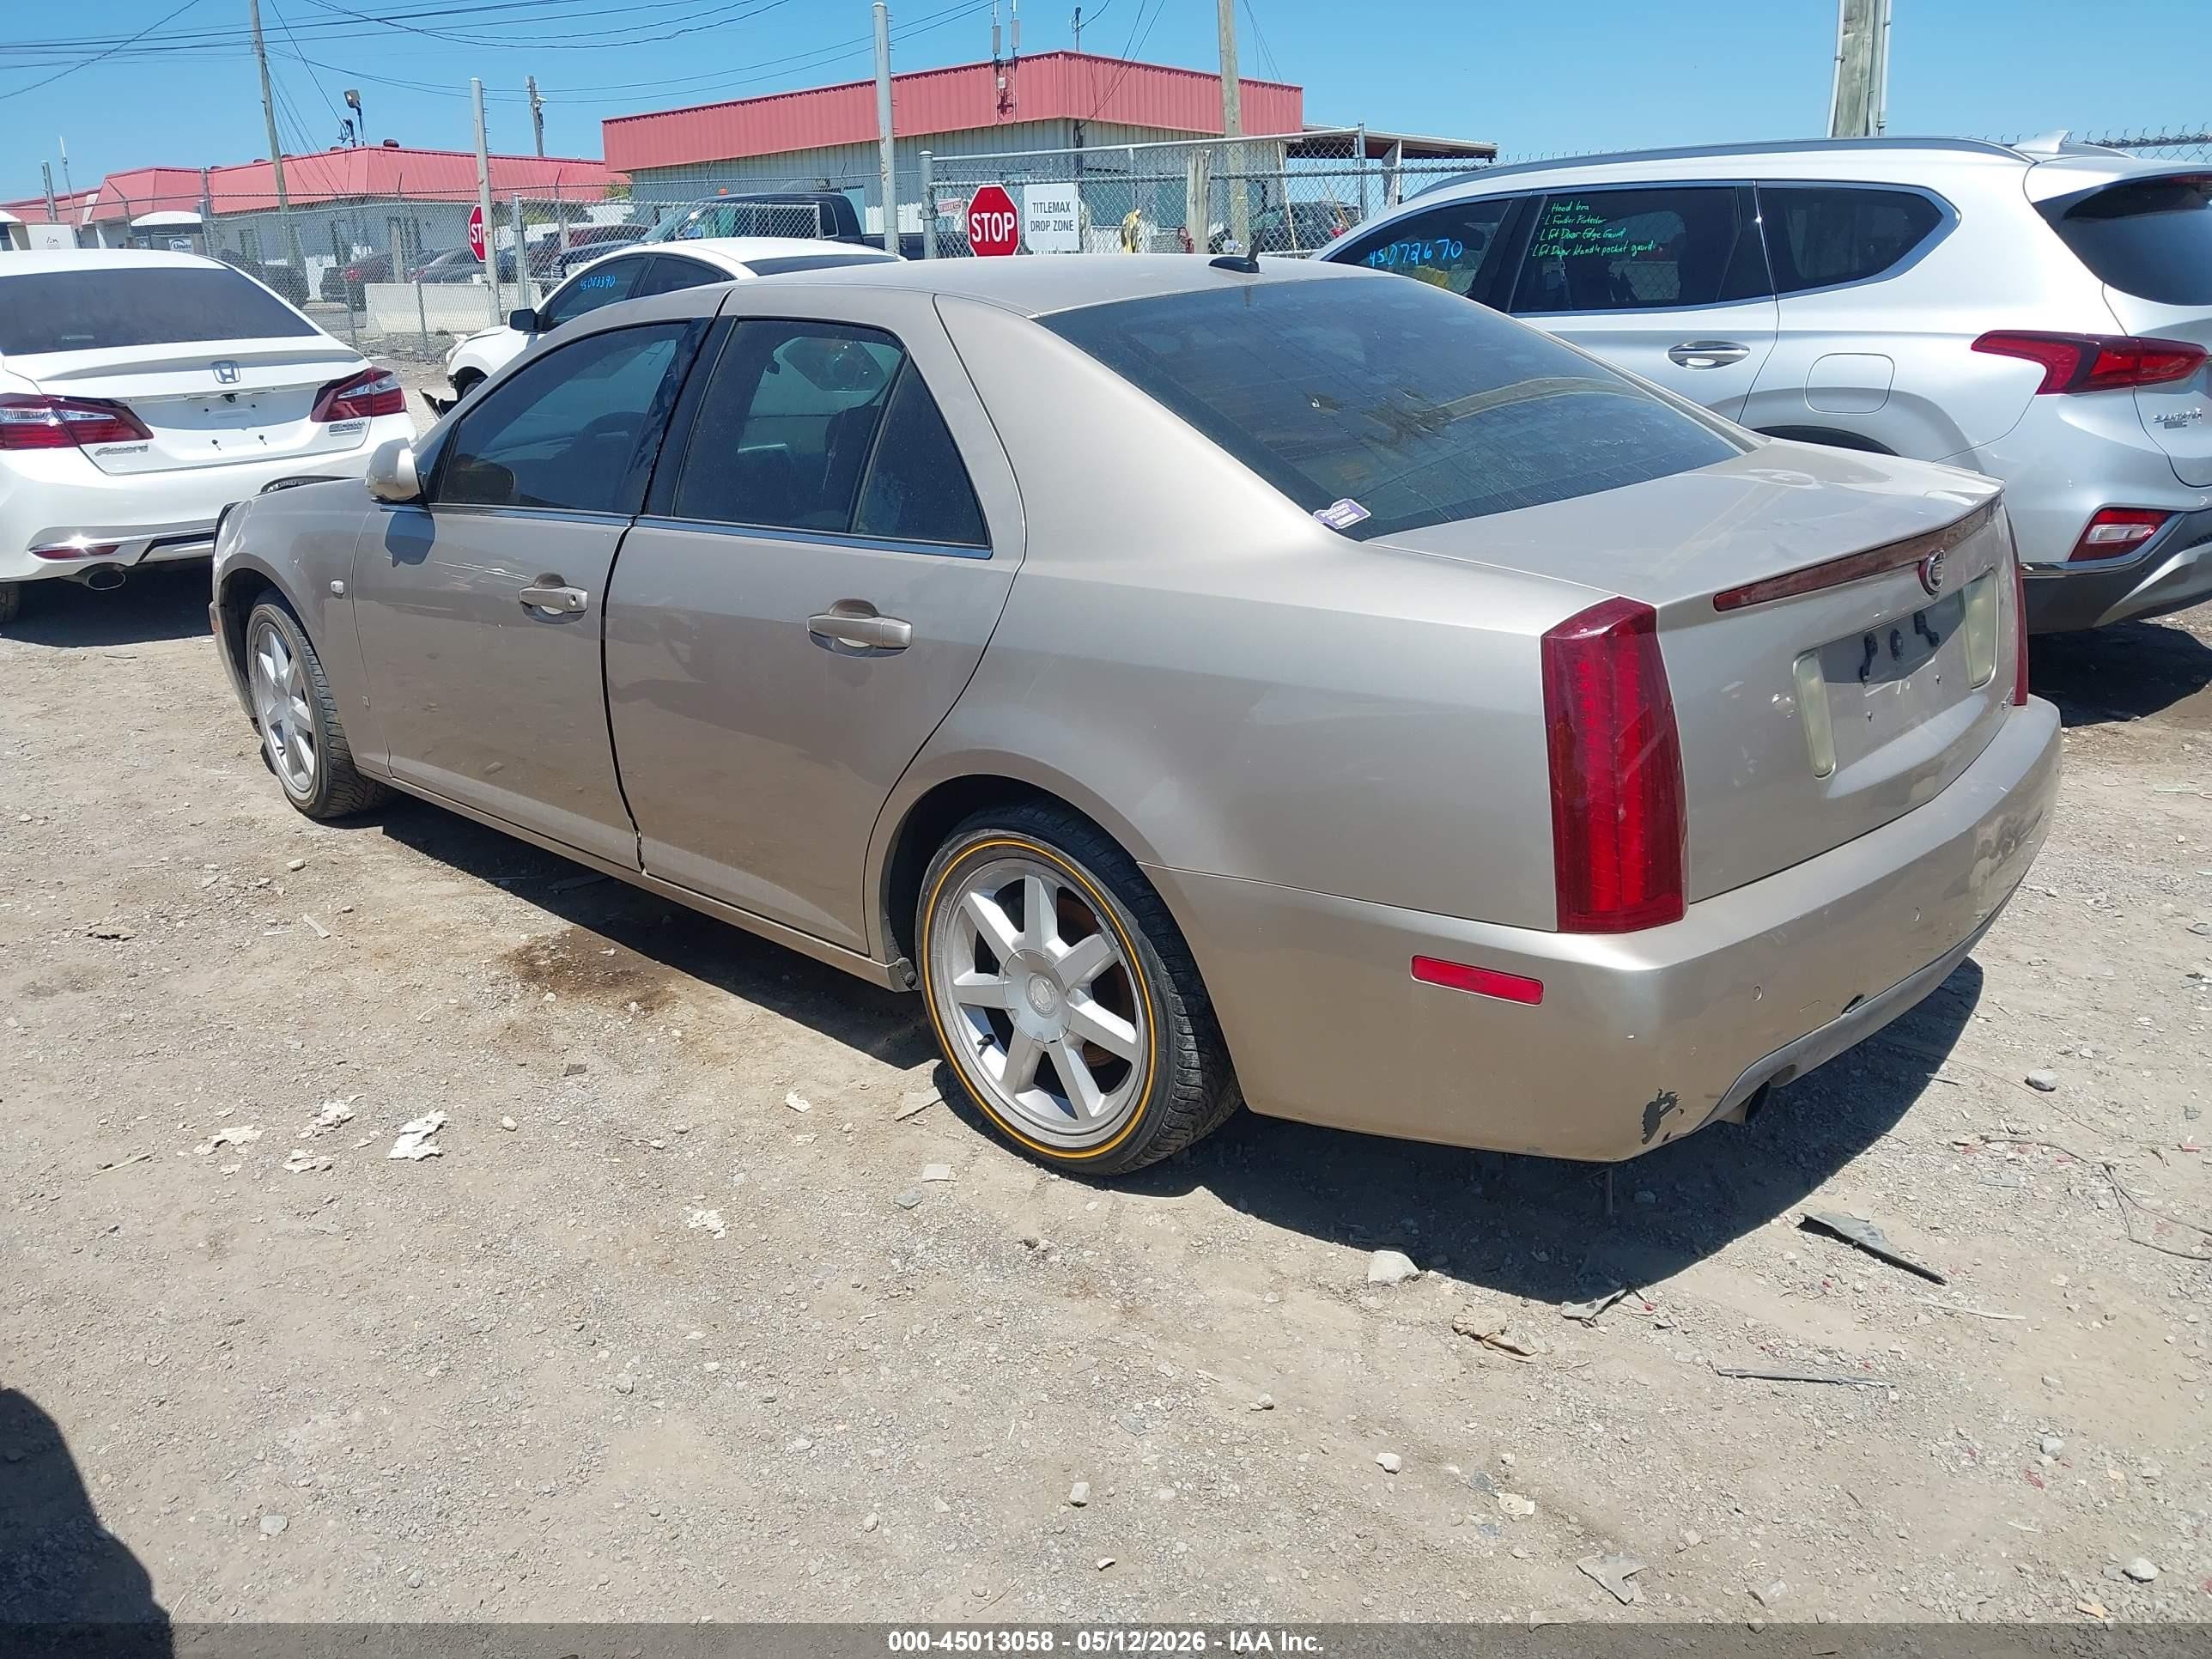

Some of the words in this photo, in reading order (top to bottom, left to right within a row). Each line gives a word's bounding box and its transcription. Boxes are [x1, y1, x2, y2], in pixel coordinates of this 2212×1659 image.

[1032, 201, 1071, 214] TITLEMAX
[471, 223, 482, 244] ST
[971, 212, 1015, 242] STOP
[1030, 220, 1050, 232] DROP
[1053, 220, 1074, 231] ZONE
